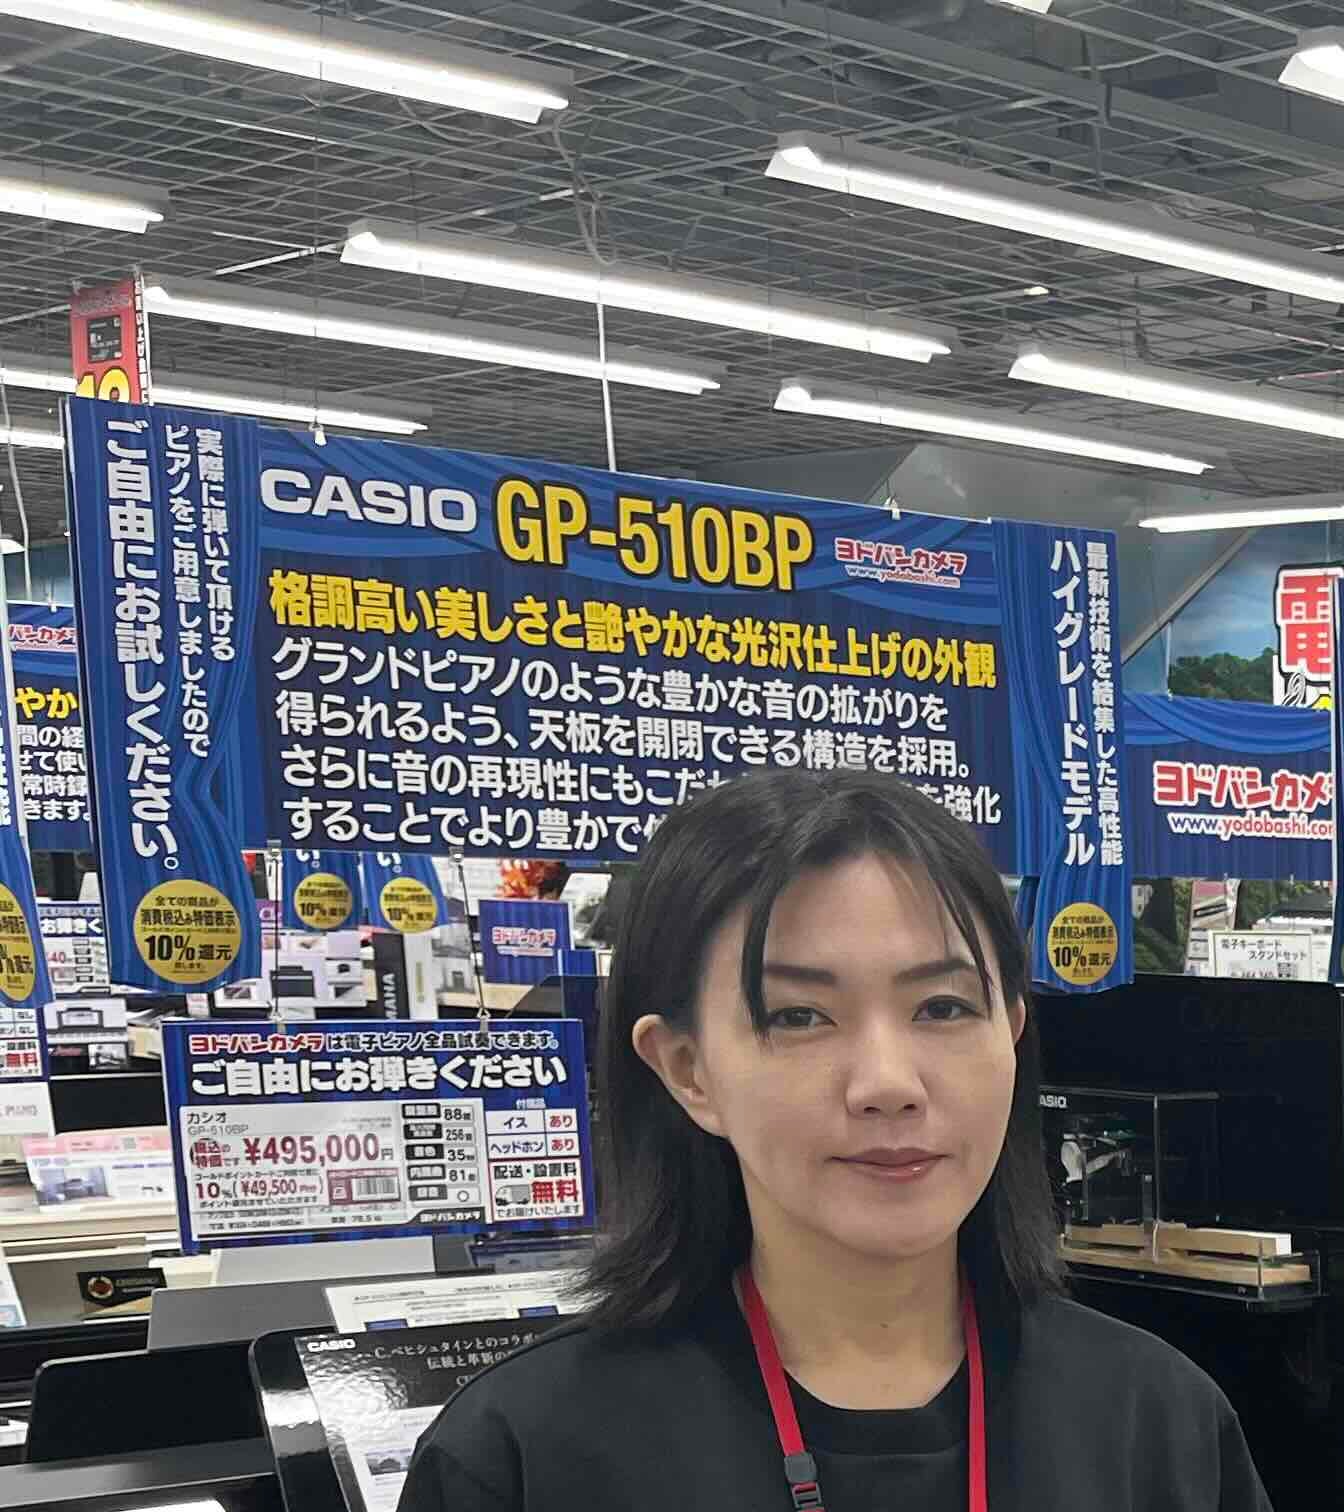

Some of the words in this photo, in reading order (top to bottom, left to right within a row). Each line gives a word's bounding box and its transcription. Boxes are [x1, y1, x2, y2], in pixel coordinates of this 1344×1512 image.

[195, 428, 235, 662] 実際に弾いて頂ける
[259, 468, 478, 534] CASIO
[498, 479, 813, 591] GP-510BP
[834, 536, 968, 576] ヨドバシカメラ
[165, 424, 210, 758] ピアノをご用意しましたので
[105, 419, 180, 872] ご自由にお試しください。
[267, 569, 998, 691] 格調高い美しさと艶やかな光沢仕上げの外観
[271, 637, 950, 733] グランドピアノのような豊かな音の拡がりを
[1050, 539, 1095, 867] ハイグレードモデル
[1084, 541, 1123, 867] 最新技術を結集した高性能
[275, 686, 971, 777] 得られるよう、天板を開閉できる構造を採用。
[1153, 760, 1335, 813] ヨドバシカメ
[144, 934, 196, 962] 10%
[1053, 944, 1088, 968] 10%
[191, 1054, 567, 1097] ご自由にお弾きください
[187, 1111, 227, 1125] カシオ
[502, 1114, 529, 1130] イス
[548, 1113, 574, 1129] あり
[1039, 1094, 1068, 1108] ASIO
[489, 1139, 545, 1155] ヘッドホン
[551, 1137, 576, 1152] あり
[531, 1181, 579, 1204] 無料
[306, 1338, 356, 1353] CASIO
